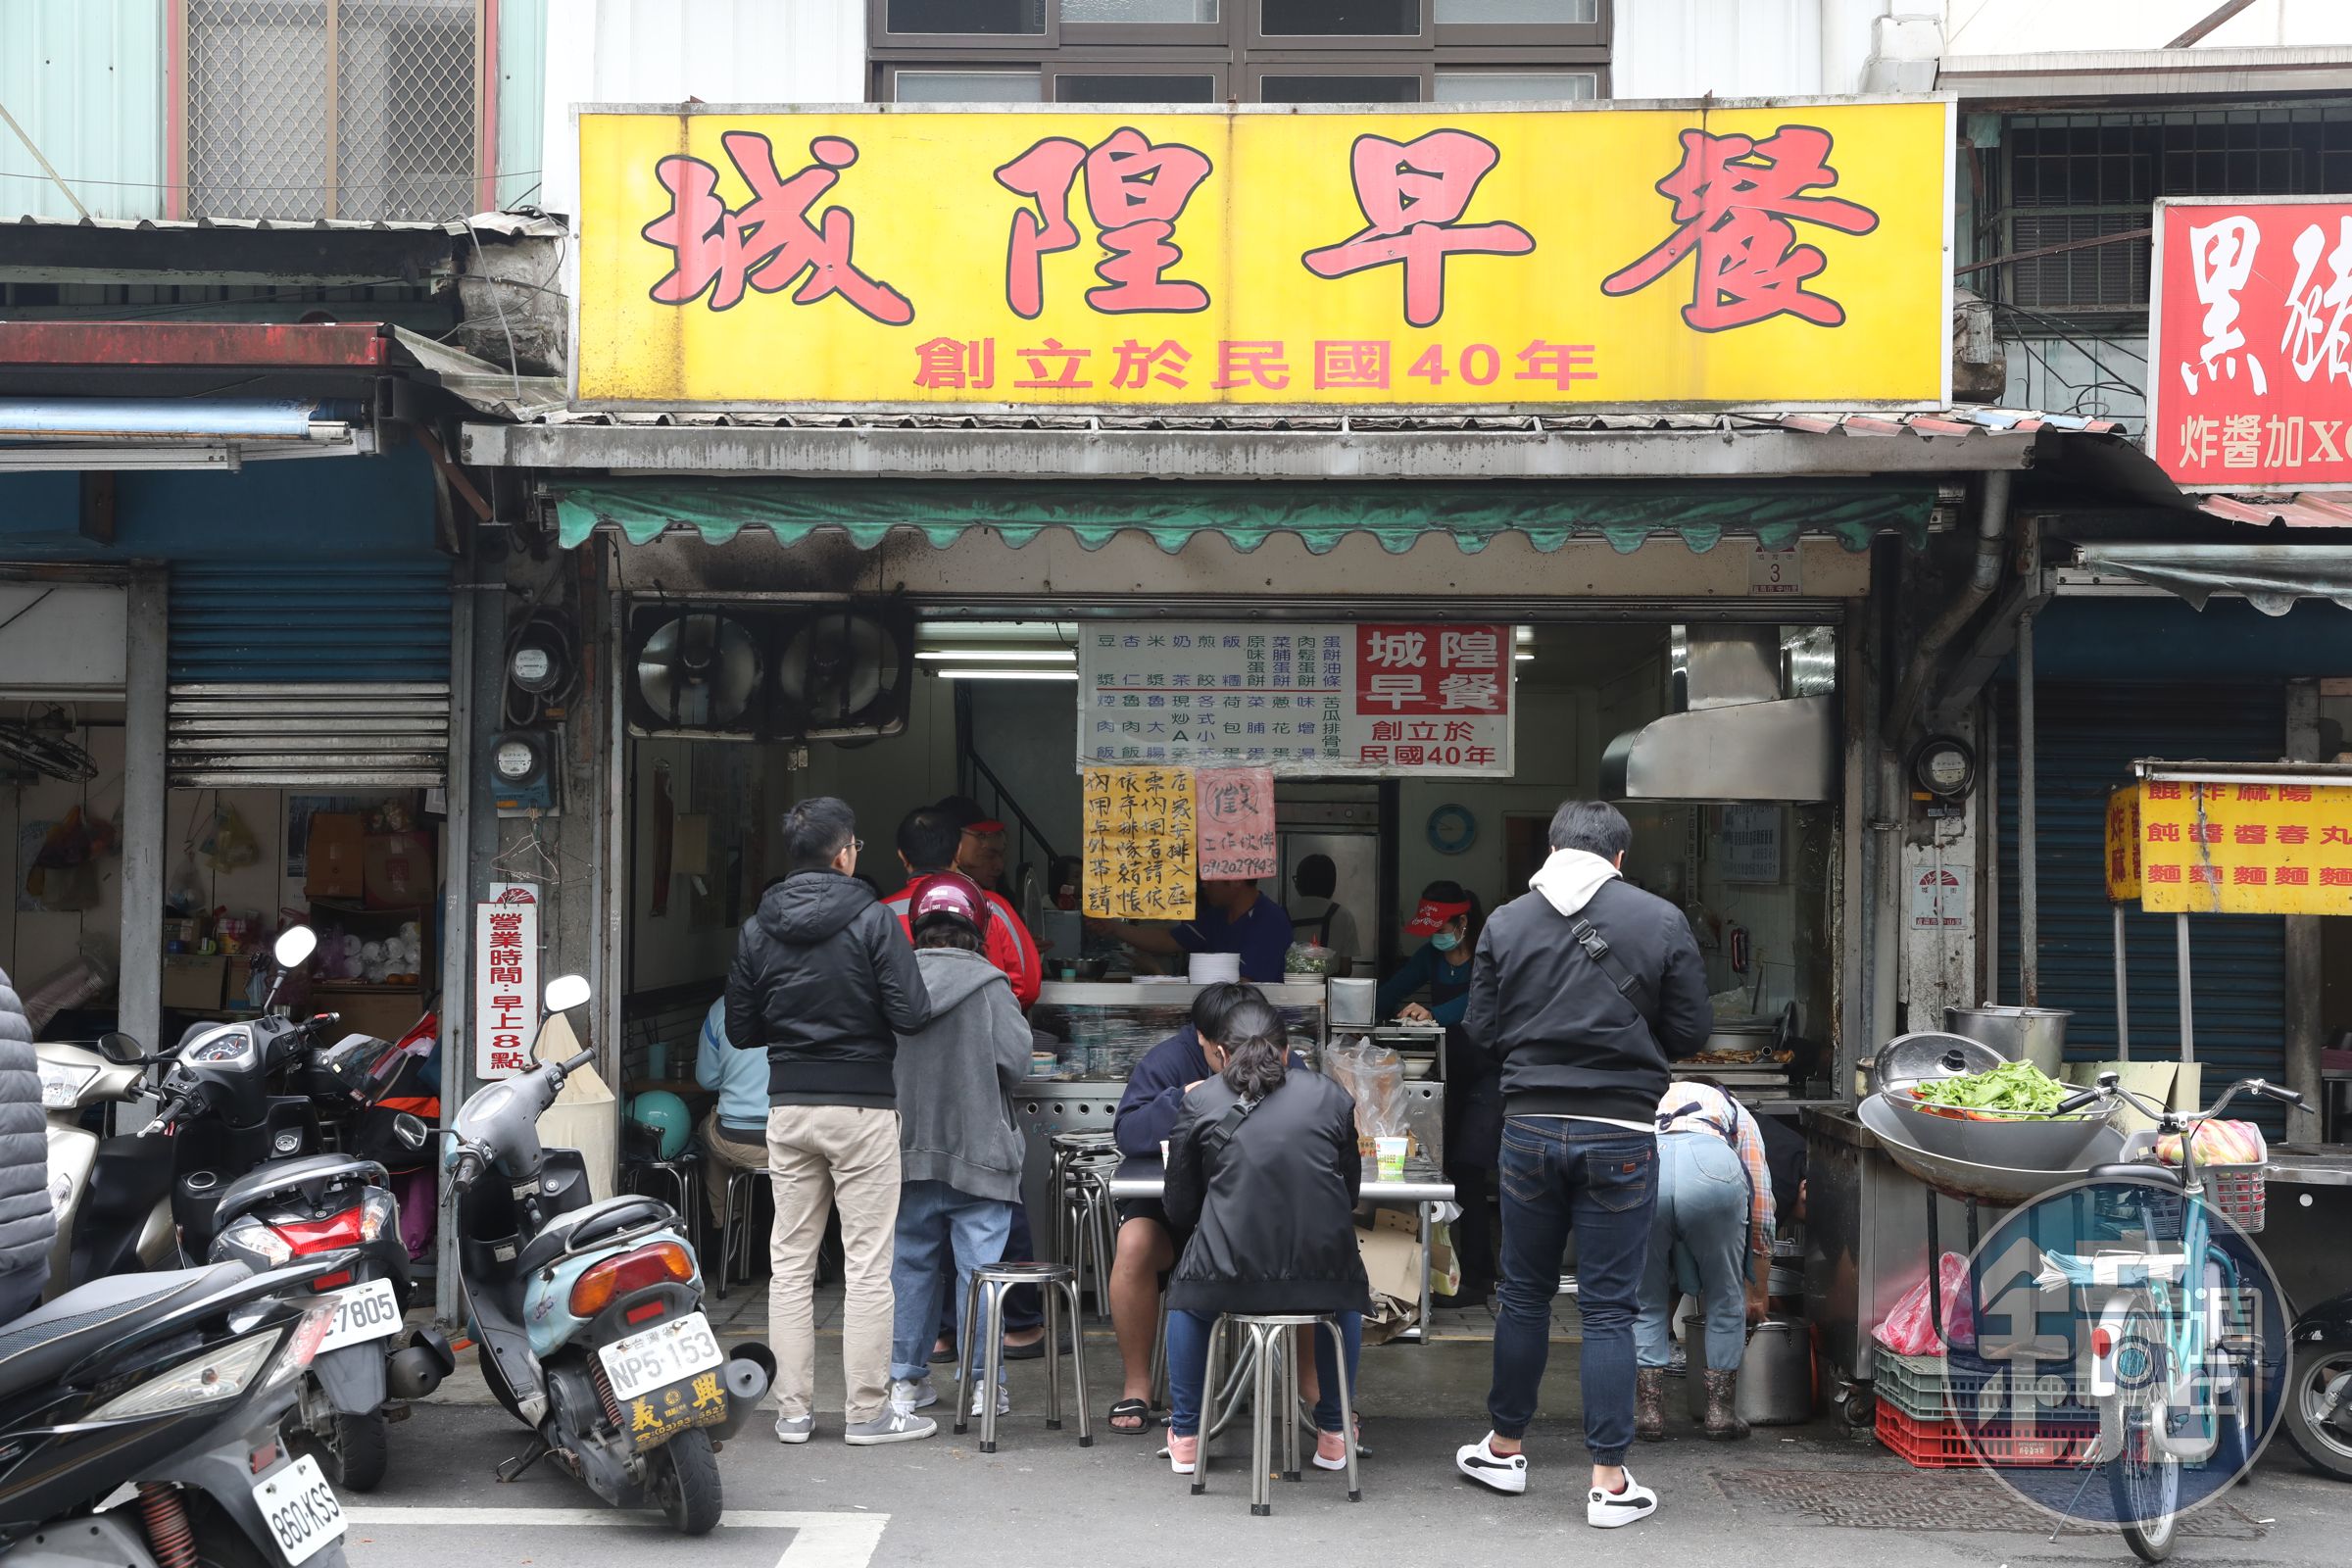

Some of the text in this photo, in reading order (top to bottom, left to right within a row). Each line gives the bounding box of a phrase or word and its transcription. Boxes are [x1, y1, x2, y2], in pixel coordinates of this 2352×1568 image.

[641, 123, 1880, 332] 城隍早餐
[914, 337, 1597, 390] 創立於民國40年
[2180, 413, 2352, 468] 炸醬加X
[1770, 564, 1781, 583] 3
[1122, 635, 1141, 687] 杏仁
[1172, 635, 1191, 687] 奶茶
[1247, 635, 1265, 687] 原味蛋餅
[1366, 631, 1499, 668] 城隍
[1365, 673, 1499, 710] 早餐
[1360, 746, 1496, 765] 民國40年
[1371, 720, 1475, 742] 創立於
[271, 1482, 340, 1550] 860-KSS
